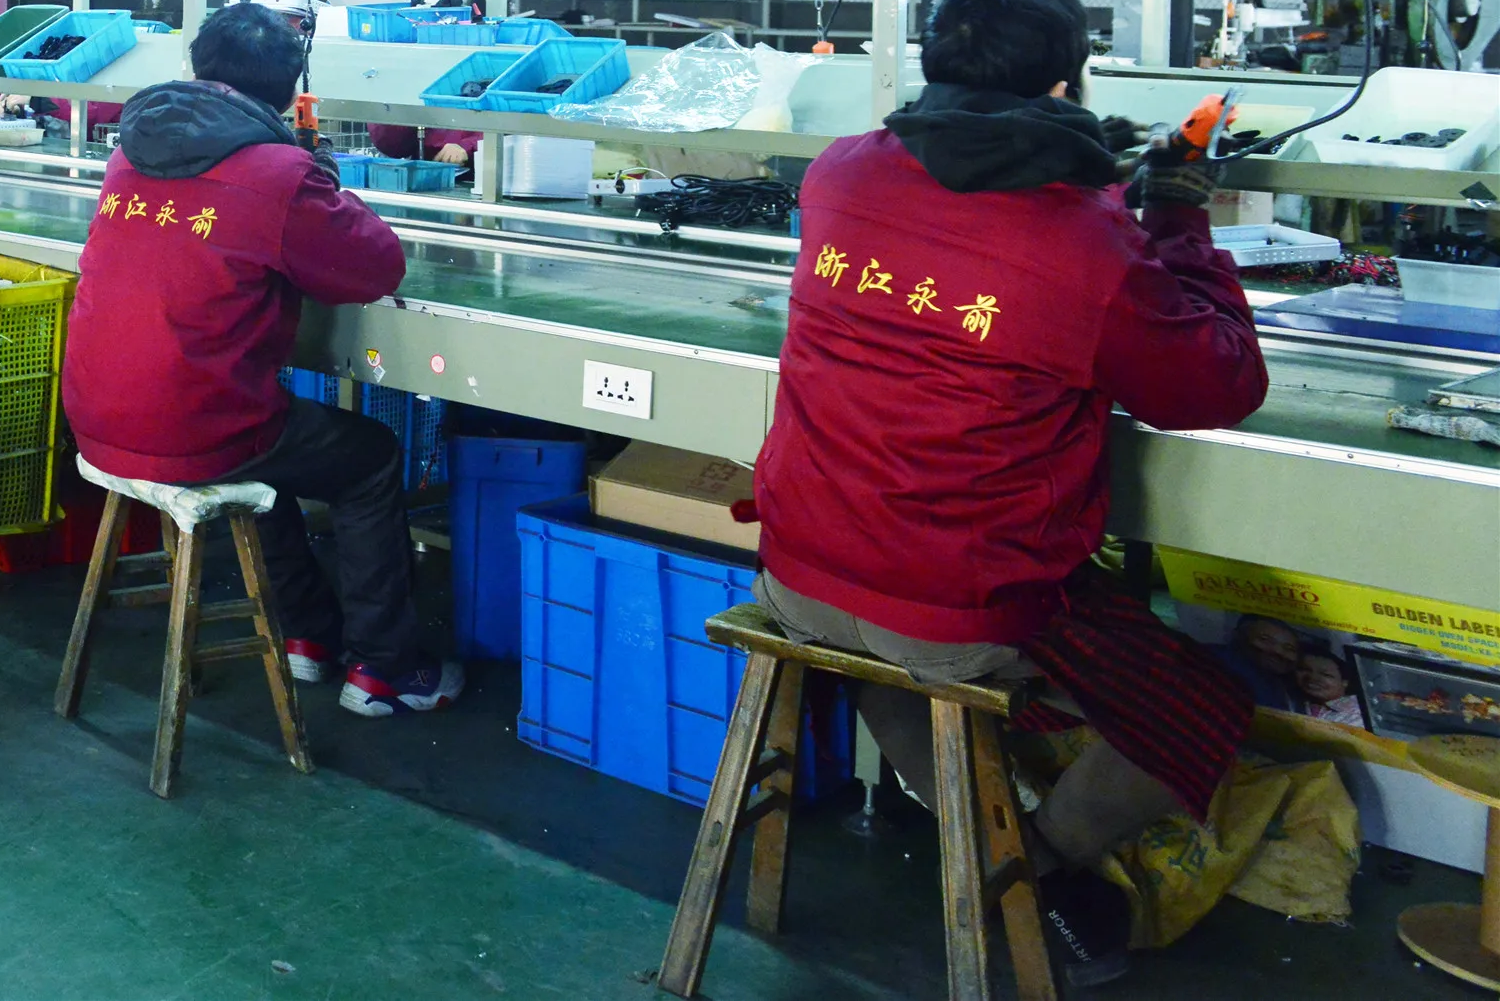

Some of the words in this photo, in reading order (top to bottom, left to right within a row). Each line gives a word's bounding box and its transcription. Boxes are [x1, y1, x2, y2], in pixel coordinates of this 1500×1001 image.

[99, 193, 218, 240] 浙江永前
[814, 244, 1001, 342] 浙江永前
[1371, 602, 1443, 627] GOLDEN
